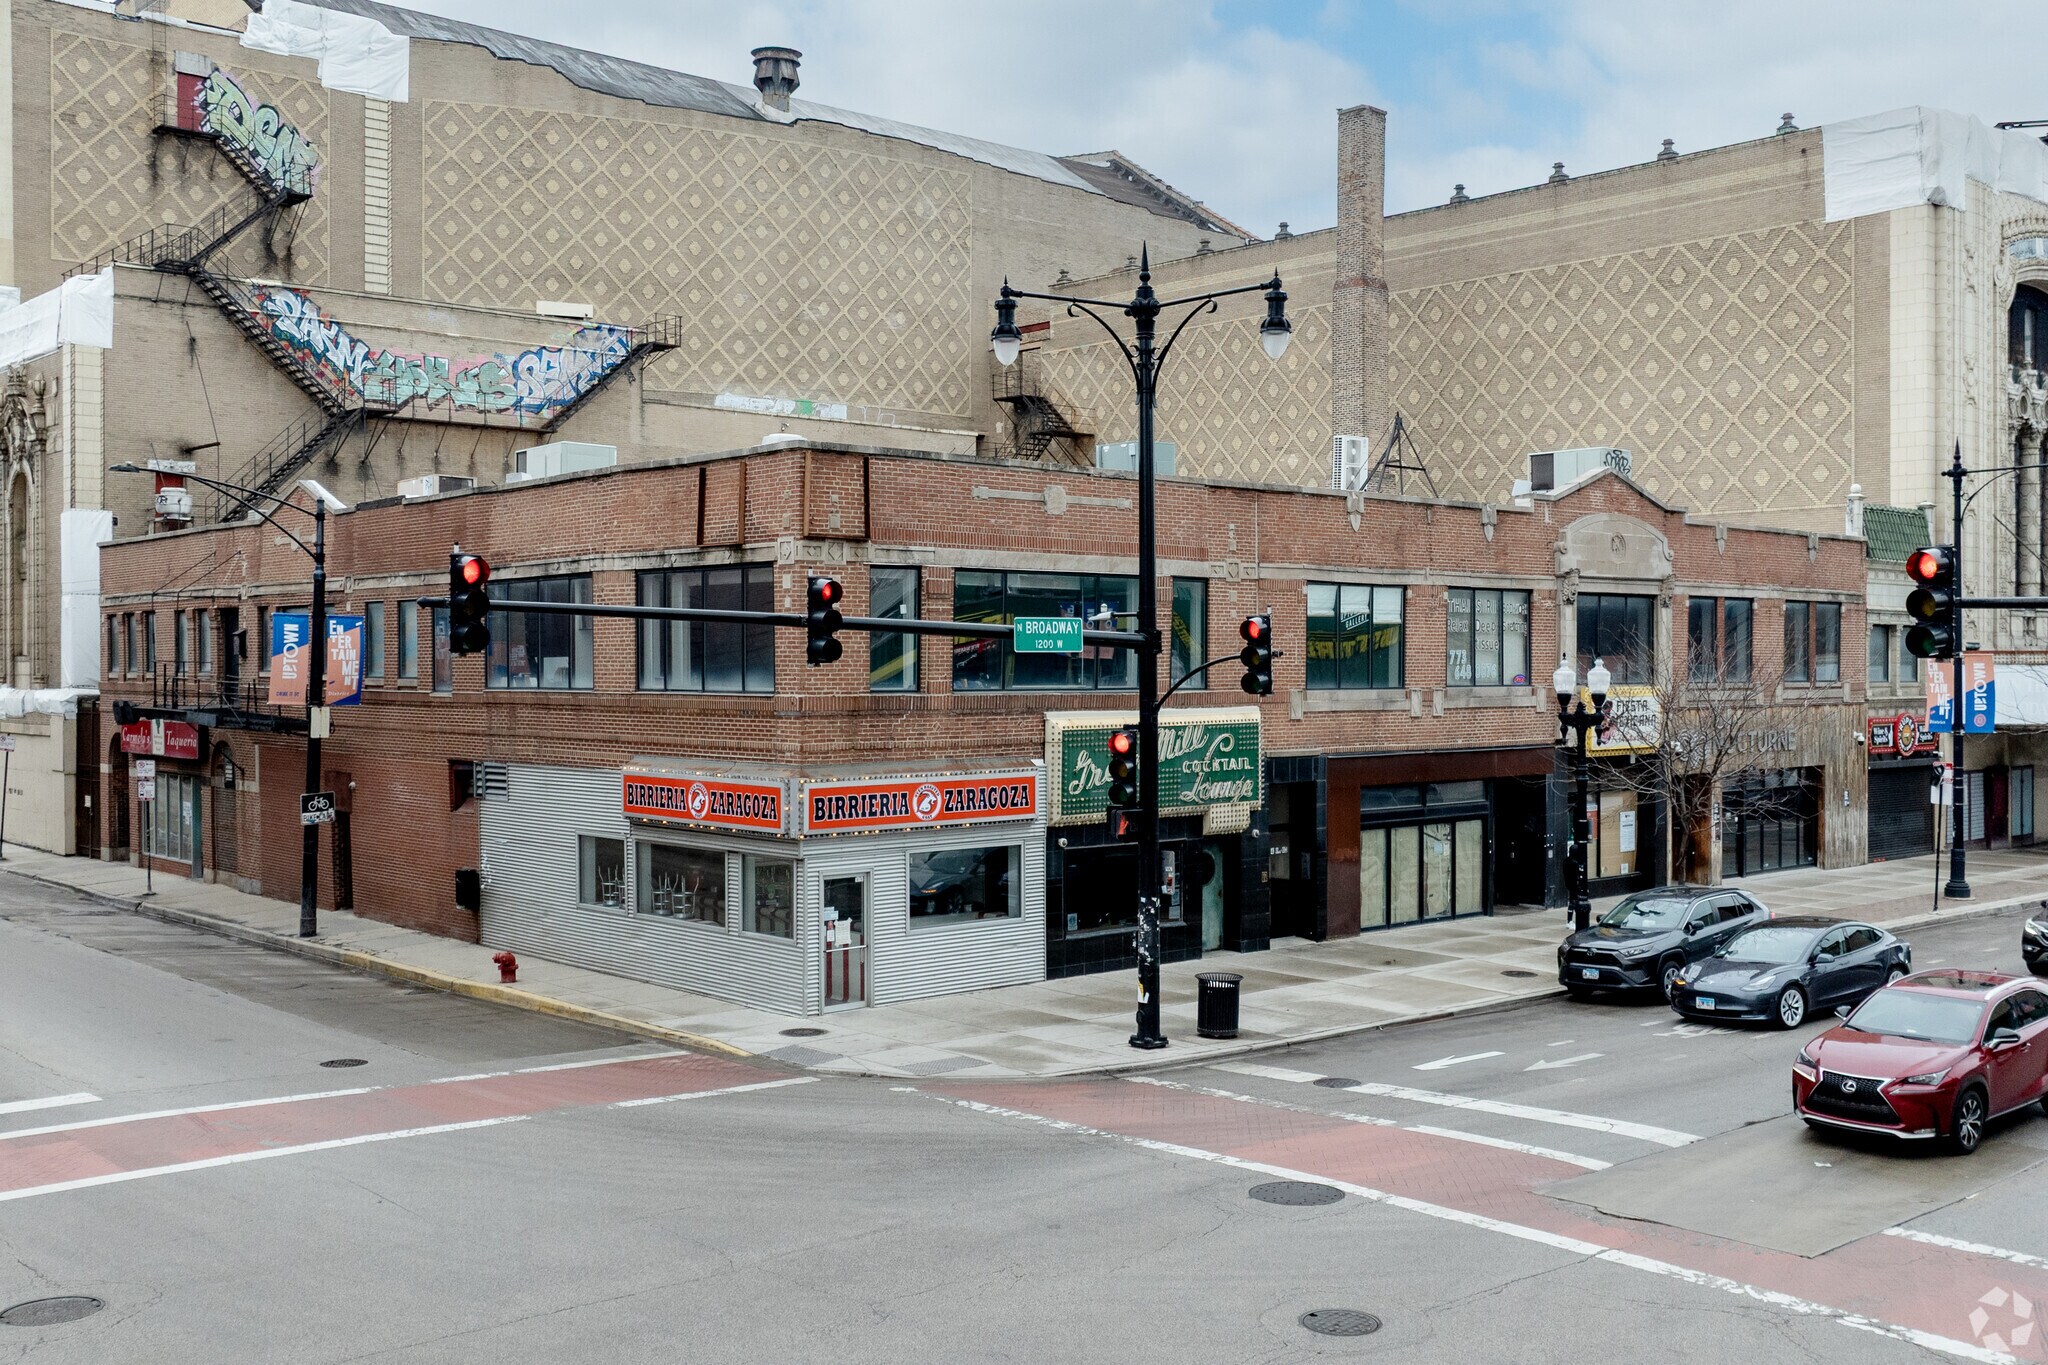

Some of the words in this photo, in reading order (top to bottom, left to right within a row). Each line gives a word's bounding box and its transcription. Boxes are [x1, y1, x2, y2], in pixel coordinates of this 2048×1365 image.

[1448, 599, 1471, 613] THAI
[1017, 623, 1022, 632] N
[1026, 621, 1079, 634] BROADWAY
[1345, 612, 1368, 629] GALLERY
[1475, 620, 1496, 634] Deep
[281, 623, 299, 680] UPTOWN
[1035, 640, 1053, 648] 1200
[1057, 640, 1063, 648] W
[331, 649, 356, 660] TAIN
[342, 660, 359, 676] ME
[1929, 684, 1948, 694] TAIN
[1973, 662, 1987, 711] UPTOWN
[166, 731, 197, 750] Taqueria
[1158, 724, 1209, 763] Mill
[1182, 757, 1254, 774] COCKTAIL
[627, 783, 687, 811] BIRRIERIA
[1180, 773, 1255, 804] Lounge
[710, 790, 778, 821] ZARAGOZA
[813, 792, 910, 822] BIRRIERIA
[944, 784, 1030, 813] ZARAGOZA
